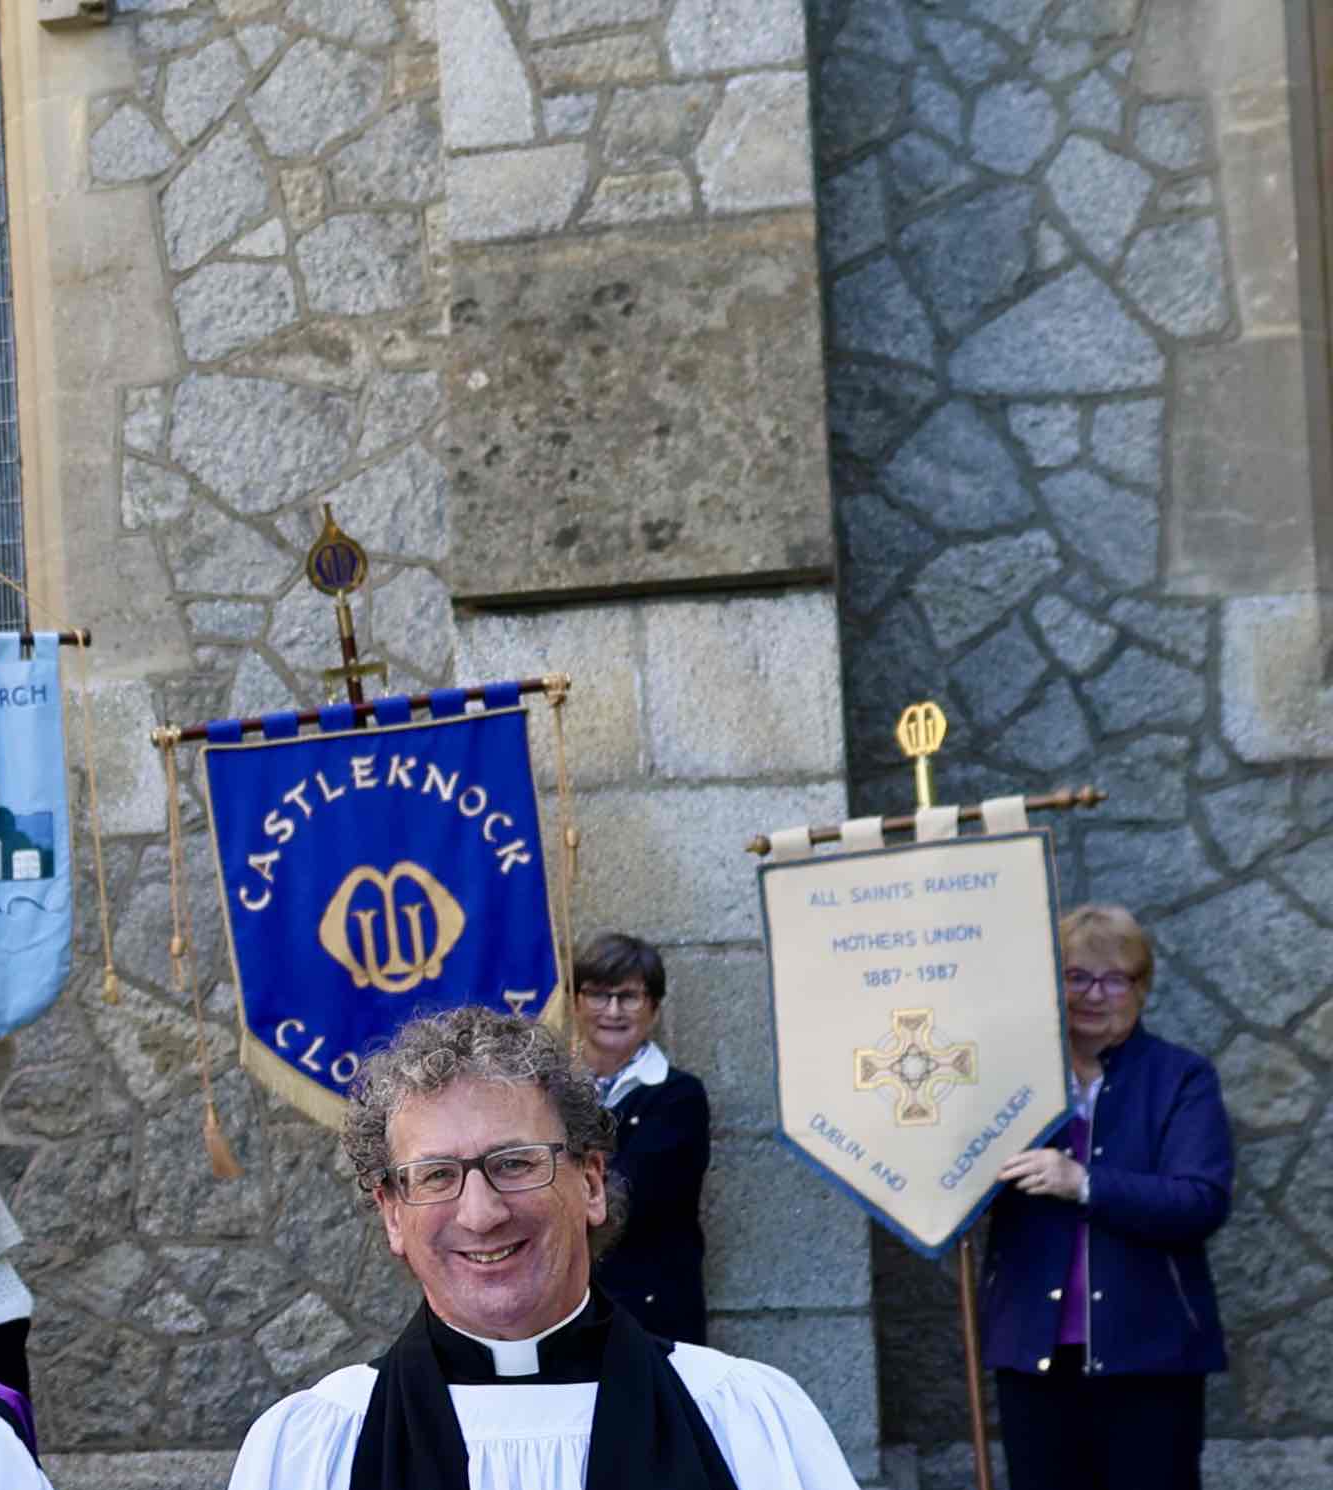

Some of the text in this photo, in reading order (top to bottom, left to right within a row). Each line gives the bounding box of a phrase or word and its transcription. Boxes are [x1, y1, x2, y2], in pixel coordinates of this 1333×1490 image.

[238, 754, 533, 912] CASTLEKNOCK
[809, 871, 999, 907] ALL SAINTS RAHENY
[832, 924, 983, 953] MOTHERS UNION
[809, 1083, 1033, 1192] DUBLIN AND GLENDALOUGH
